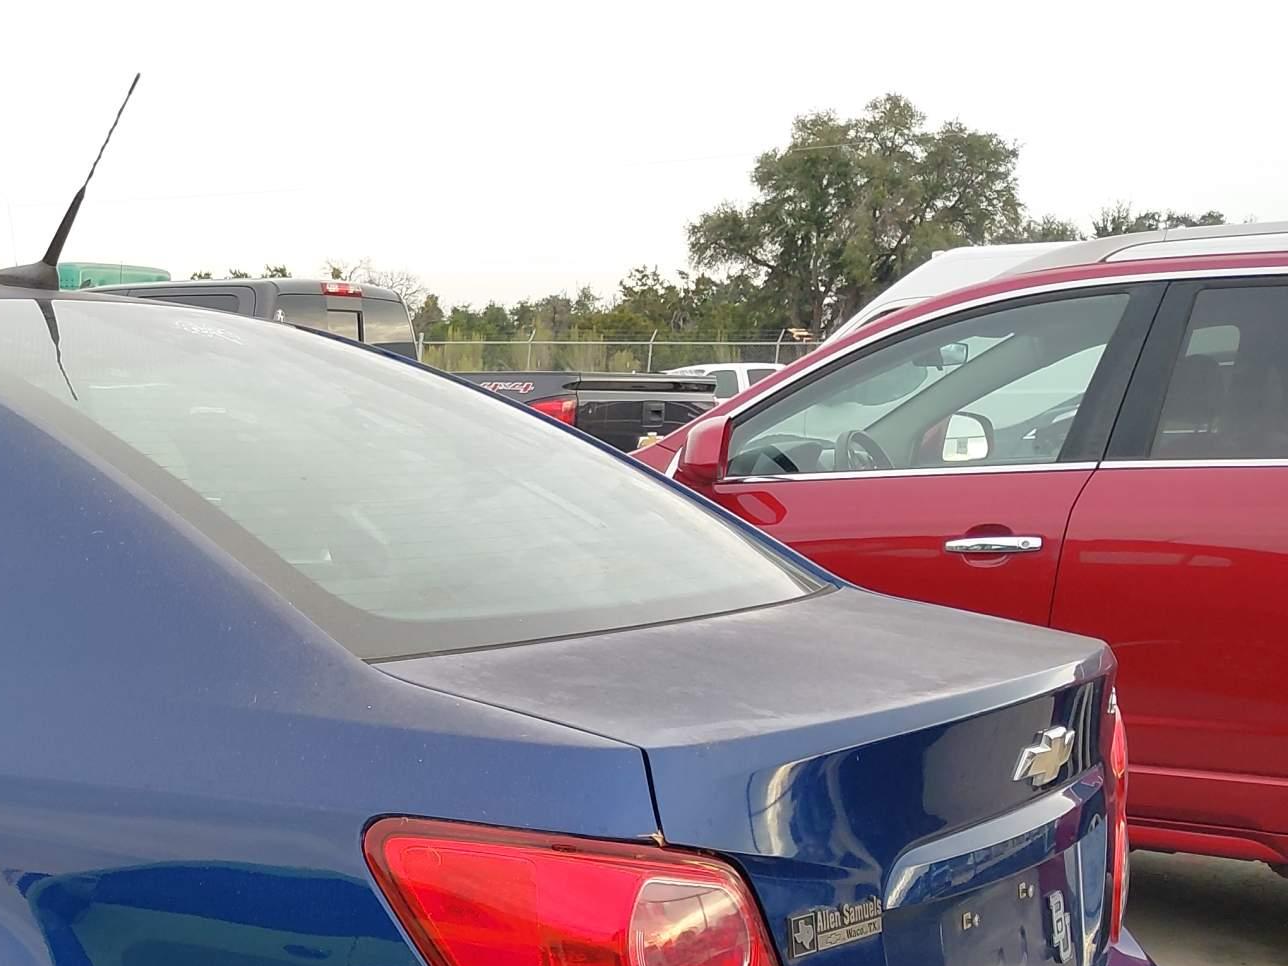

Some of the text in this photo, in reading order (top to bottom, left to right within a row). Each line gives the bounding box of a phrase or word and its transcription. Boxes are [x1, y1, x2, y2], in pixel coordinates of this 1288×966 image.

[817, 895, 882, 932] Allen Samuels
[867, 921, 878, 933] TX
